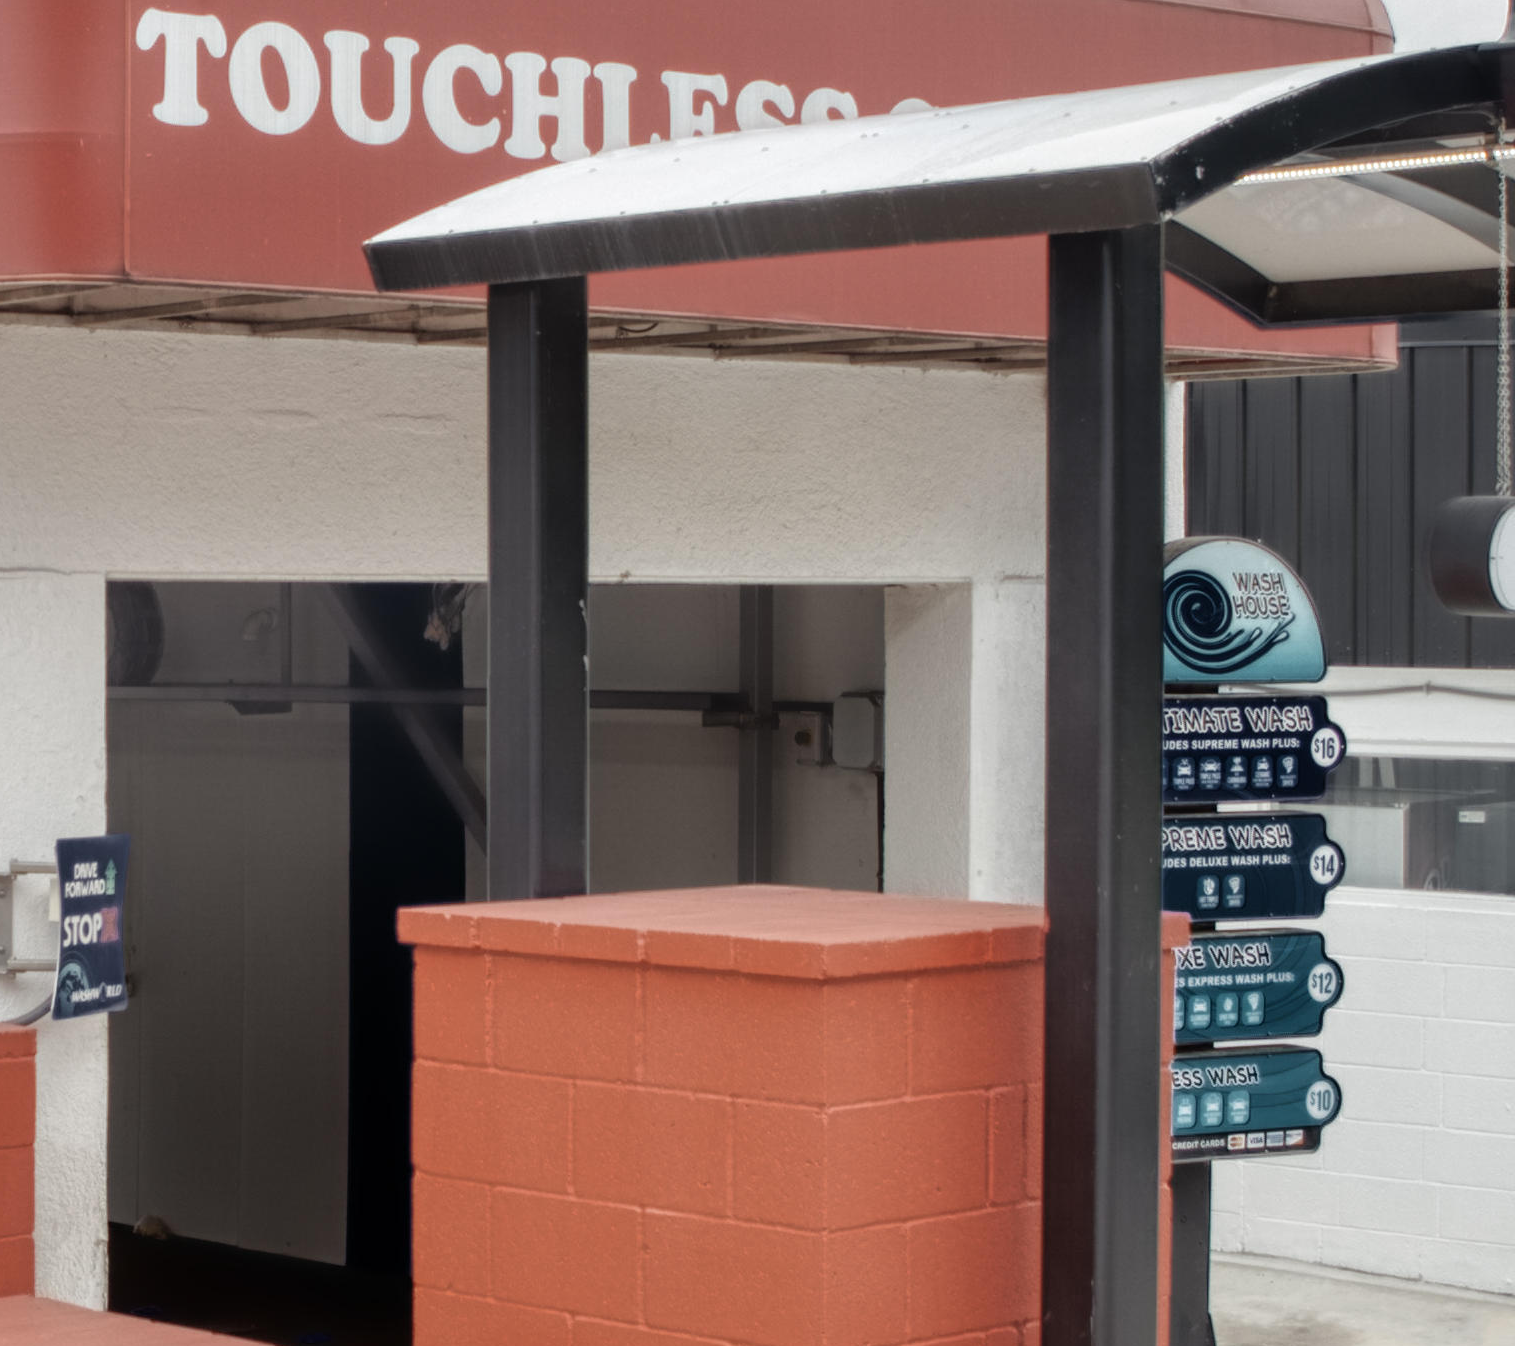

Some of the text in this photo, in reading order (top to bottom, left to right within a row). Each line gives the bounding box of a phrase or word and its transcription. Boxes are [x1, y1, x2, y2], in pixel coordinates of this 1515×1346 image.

[1232, 572, 1285, 595] WASH
[1232, 595, 1290, 619] HOUSE
[1163, 705, 1313, 733] TIMATE WASH
[1191, 739, 1238, 750] SUPREME
[1240, 738, 1270, 749] WASH
[1272, 738, 1300, 748] PLUS:
[1314, 737, 1336, 759] $16
[1162, 824, 1293, 852] PREME WASH
[74, 861, 98, 880] DRIVE
[1189, 857, 1229, 868] DELUXE
[1231, 856, 1260, 866] WASH
[1262, 854, 1291, 865] PLUS:
[1313, 854, 1335, 876] $14
[64, 878, 106, 898] FORWARD
[63, 912, 103, 947] STOP
[1208, 943, 1272, 969] WASH
[1188, 975, 1233, 987] EXPRESS
[1235, 973, 1264, 985] WASH
[1266, 972, 1295, 983] PLUS:
[1311, 971, 1334, 995] $12
[1206, 1063, 1260, 1087] WASH
[1310, 1089, 1331, 1111] $10
[1172, 1138, 1226, 1150] CREDIT CARDS
